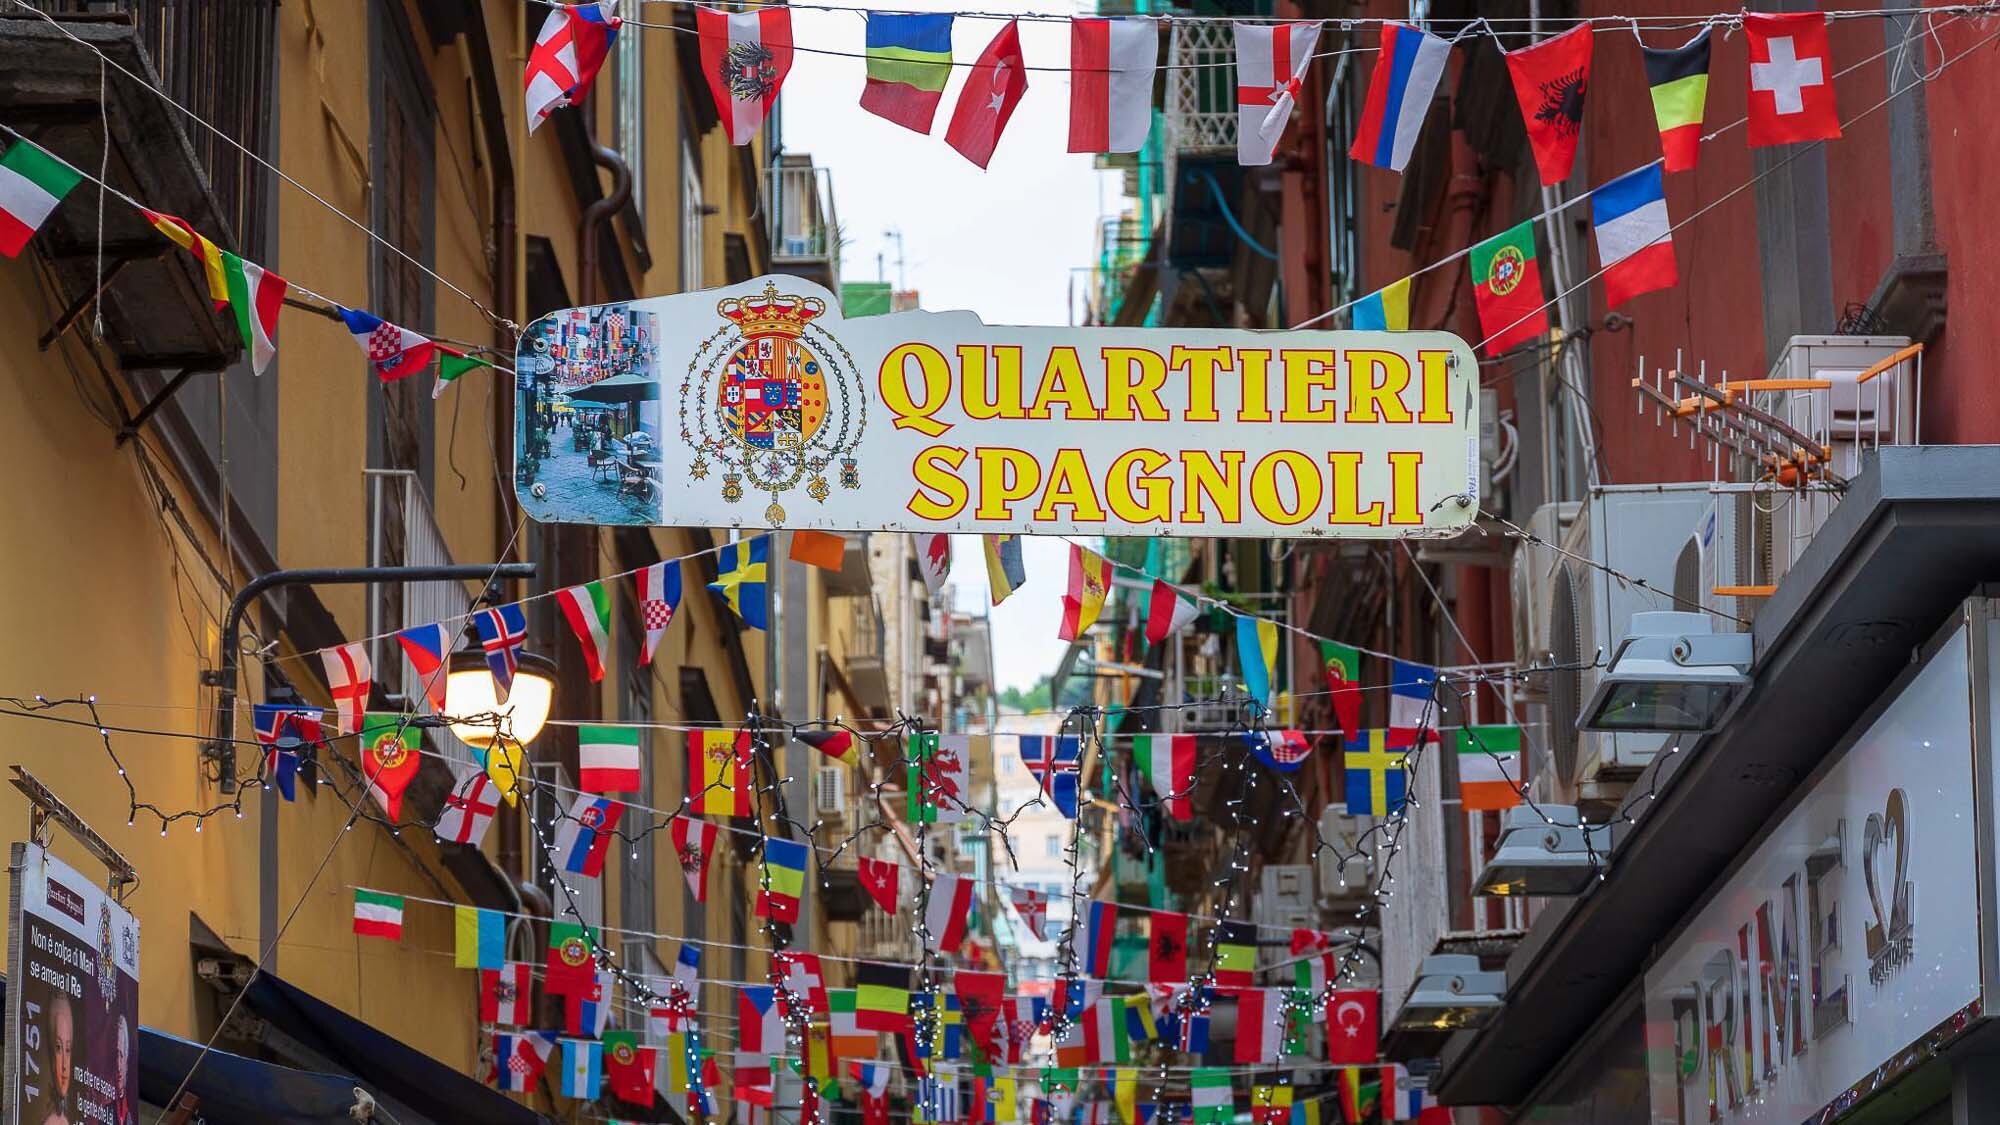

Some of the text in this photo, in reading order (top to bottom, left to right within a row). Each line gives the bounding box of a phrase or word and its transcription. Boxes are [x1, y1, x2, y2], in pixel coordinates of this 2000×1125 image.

[878, 342, 1454, 438] QUARTIERI
[906, 445, 1424, 528] SPAGNOLI
[30, 961, 40, 978] se
[41, 965, 65, 990] amava
[70, 975, 82, 999] Re
[31, 924, 47, 951] Non
[54, 940, 72, 966] colpa
[79, 949, 94, 977] Mari
[1671, 818, 1855, 1125] PRIME
[24, 1000, 41, 1104] 1751
